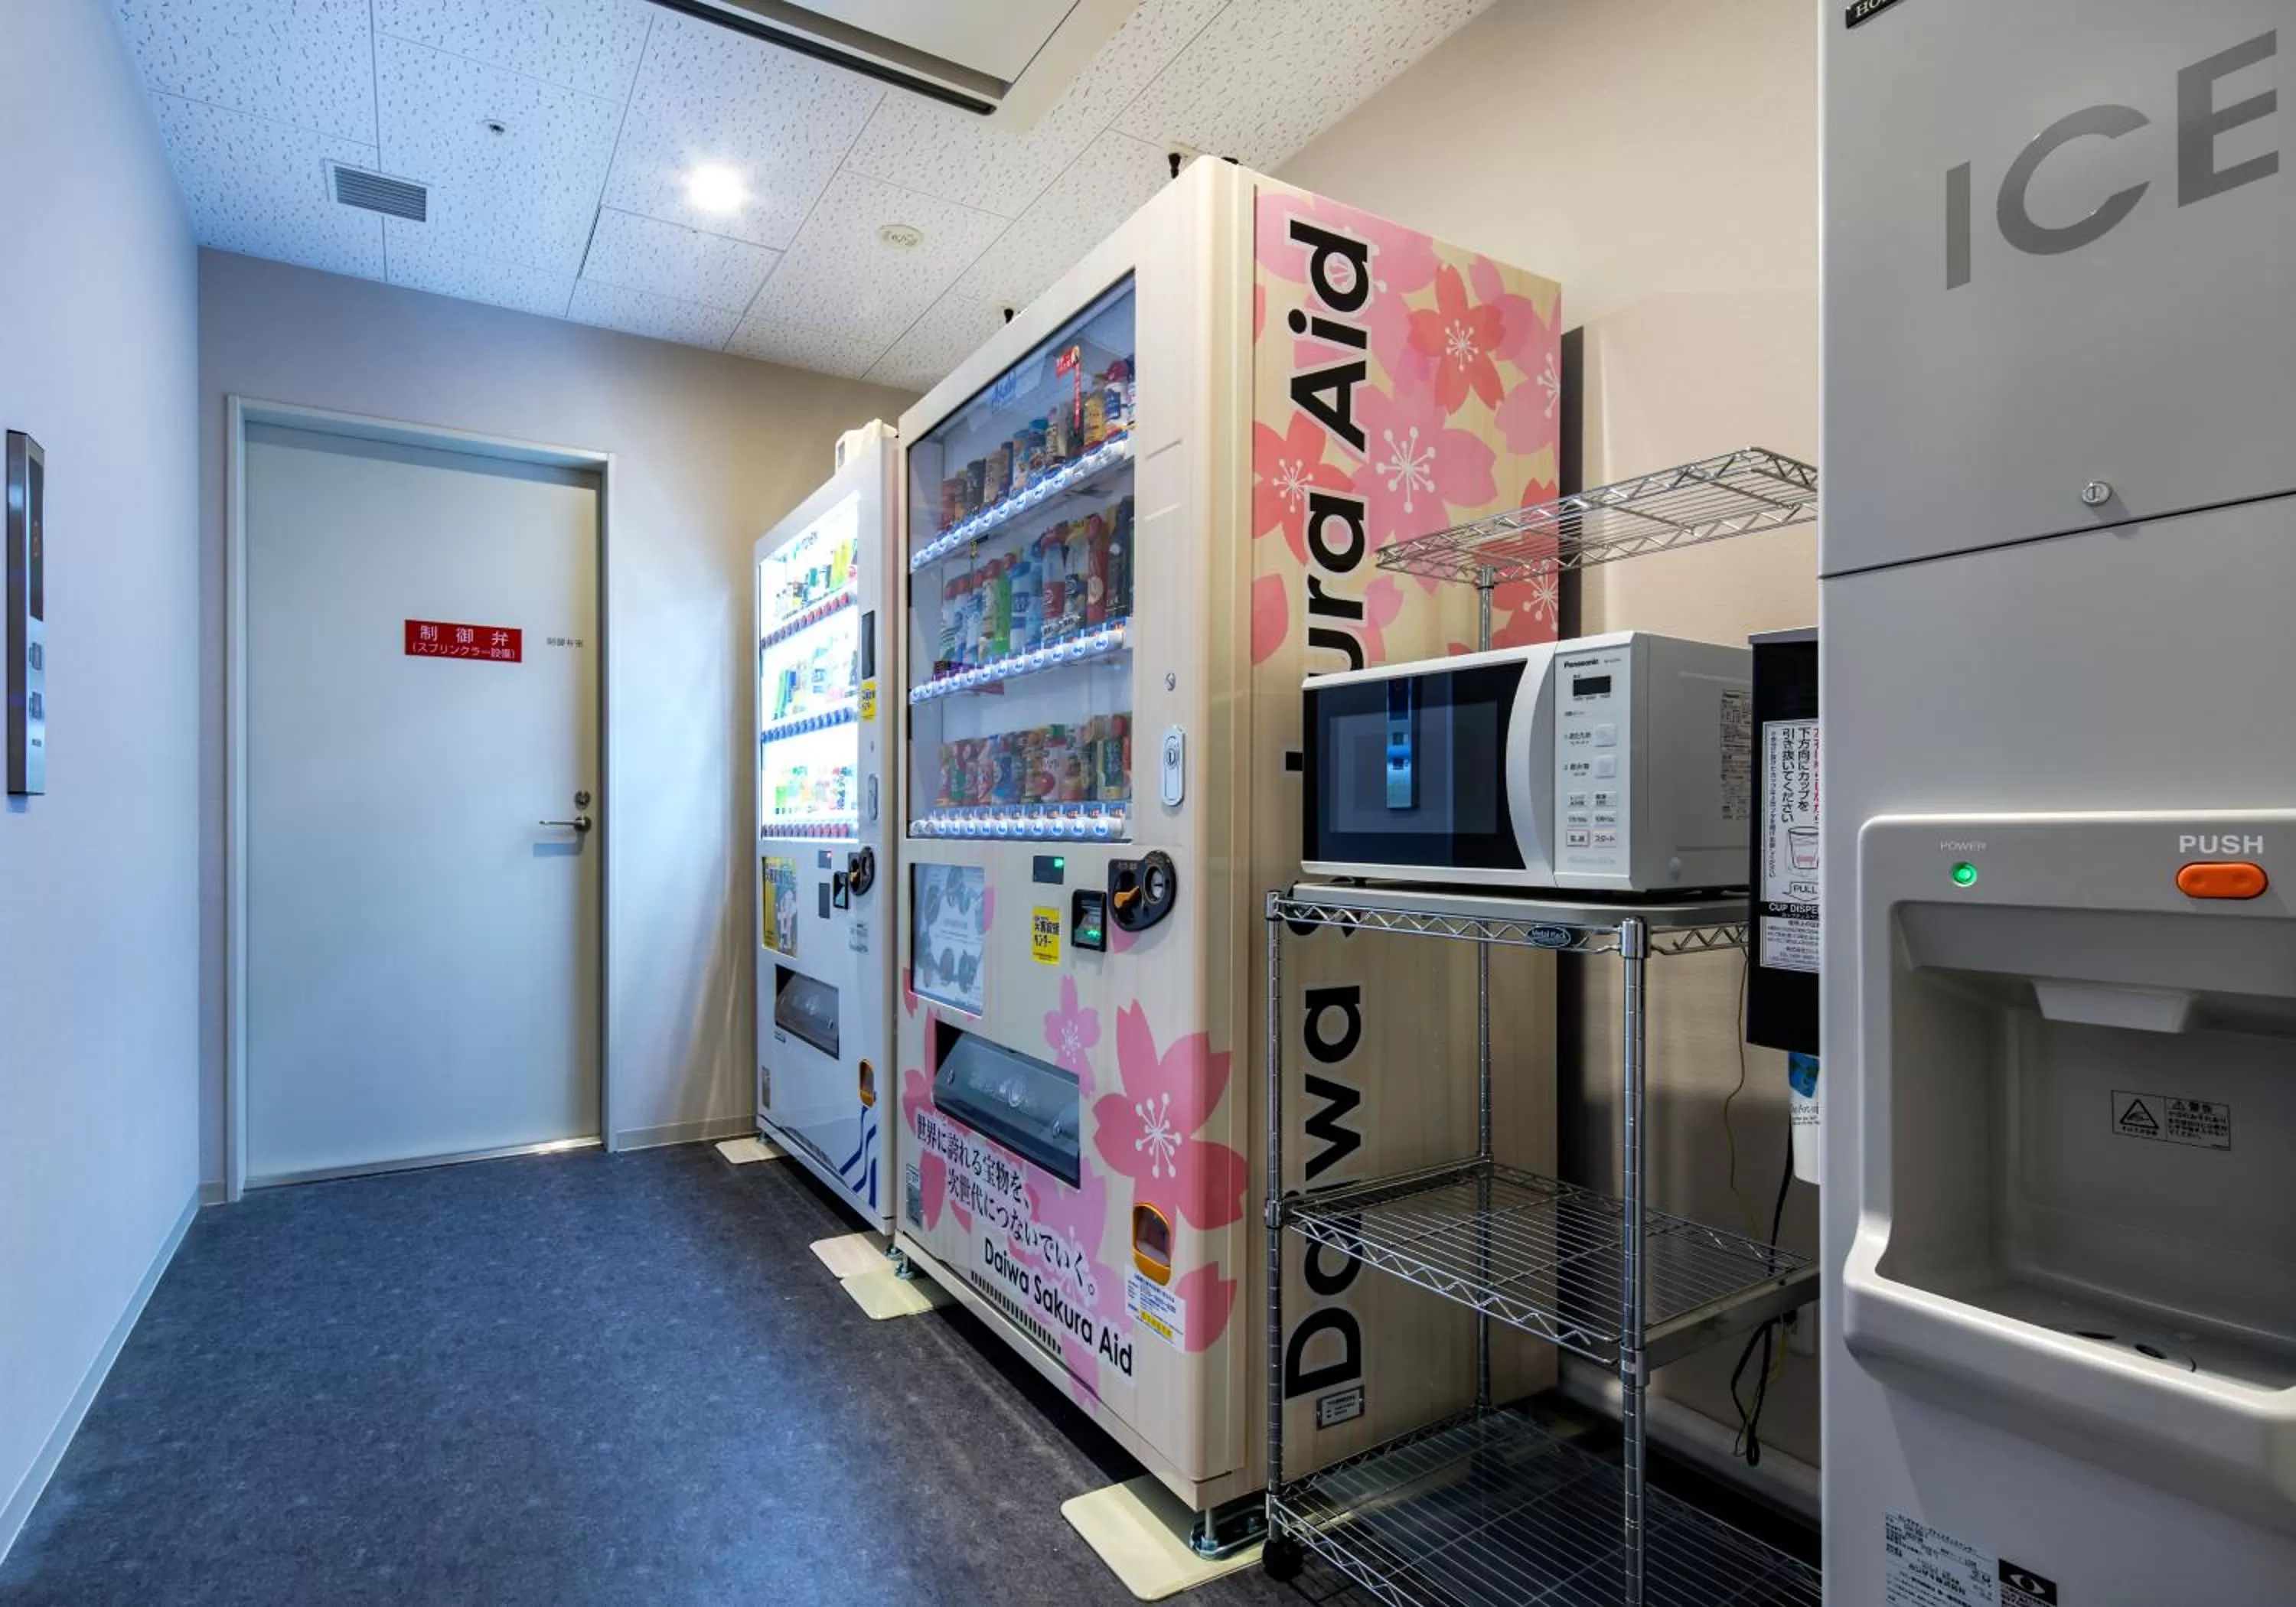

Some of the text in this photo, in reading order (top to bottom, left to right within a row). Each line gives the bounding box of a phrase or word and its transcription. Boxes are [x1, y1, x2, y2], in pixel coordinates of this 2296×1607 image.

[1946, 28, 2279, 291] ICE
[1287, 218, 1368, 454] Aid
[420, 624, 509, 647] 制御弁
[1939, 840, 1988, 852] POWER
[2178, 835, 2265, 855] PUSH
[1793, 884, 1818, 895] PULL
[1769, 902, 1788, 912] CUP
[947, 1167, 1096, 1296] 次世代につないでいく。
[984, 1237, 1029, 1296] Daiwa
[1033, 1276, 1093, 1343] Sakura
[1098, 1325, 1133, 1377] Aid
